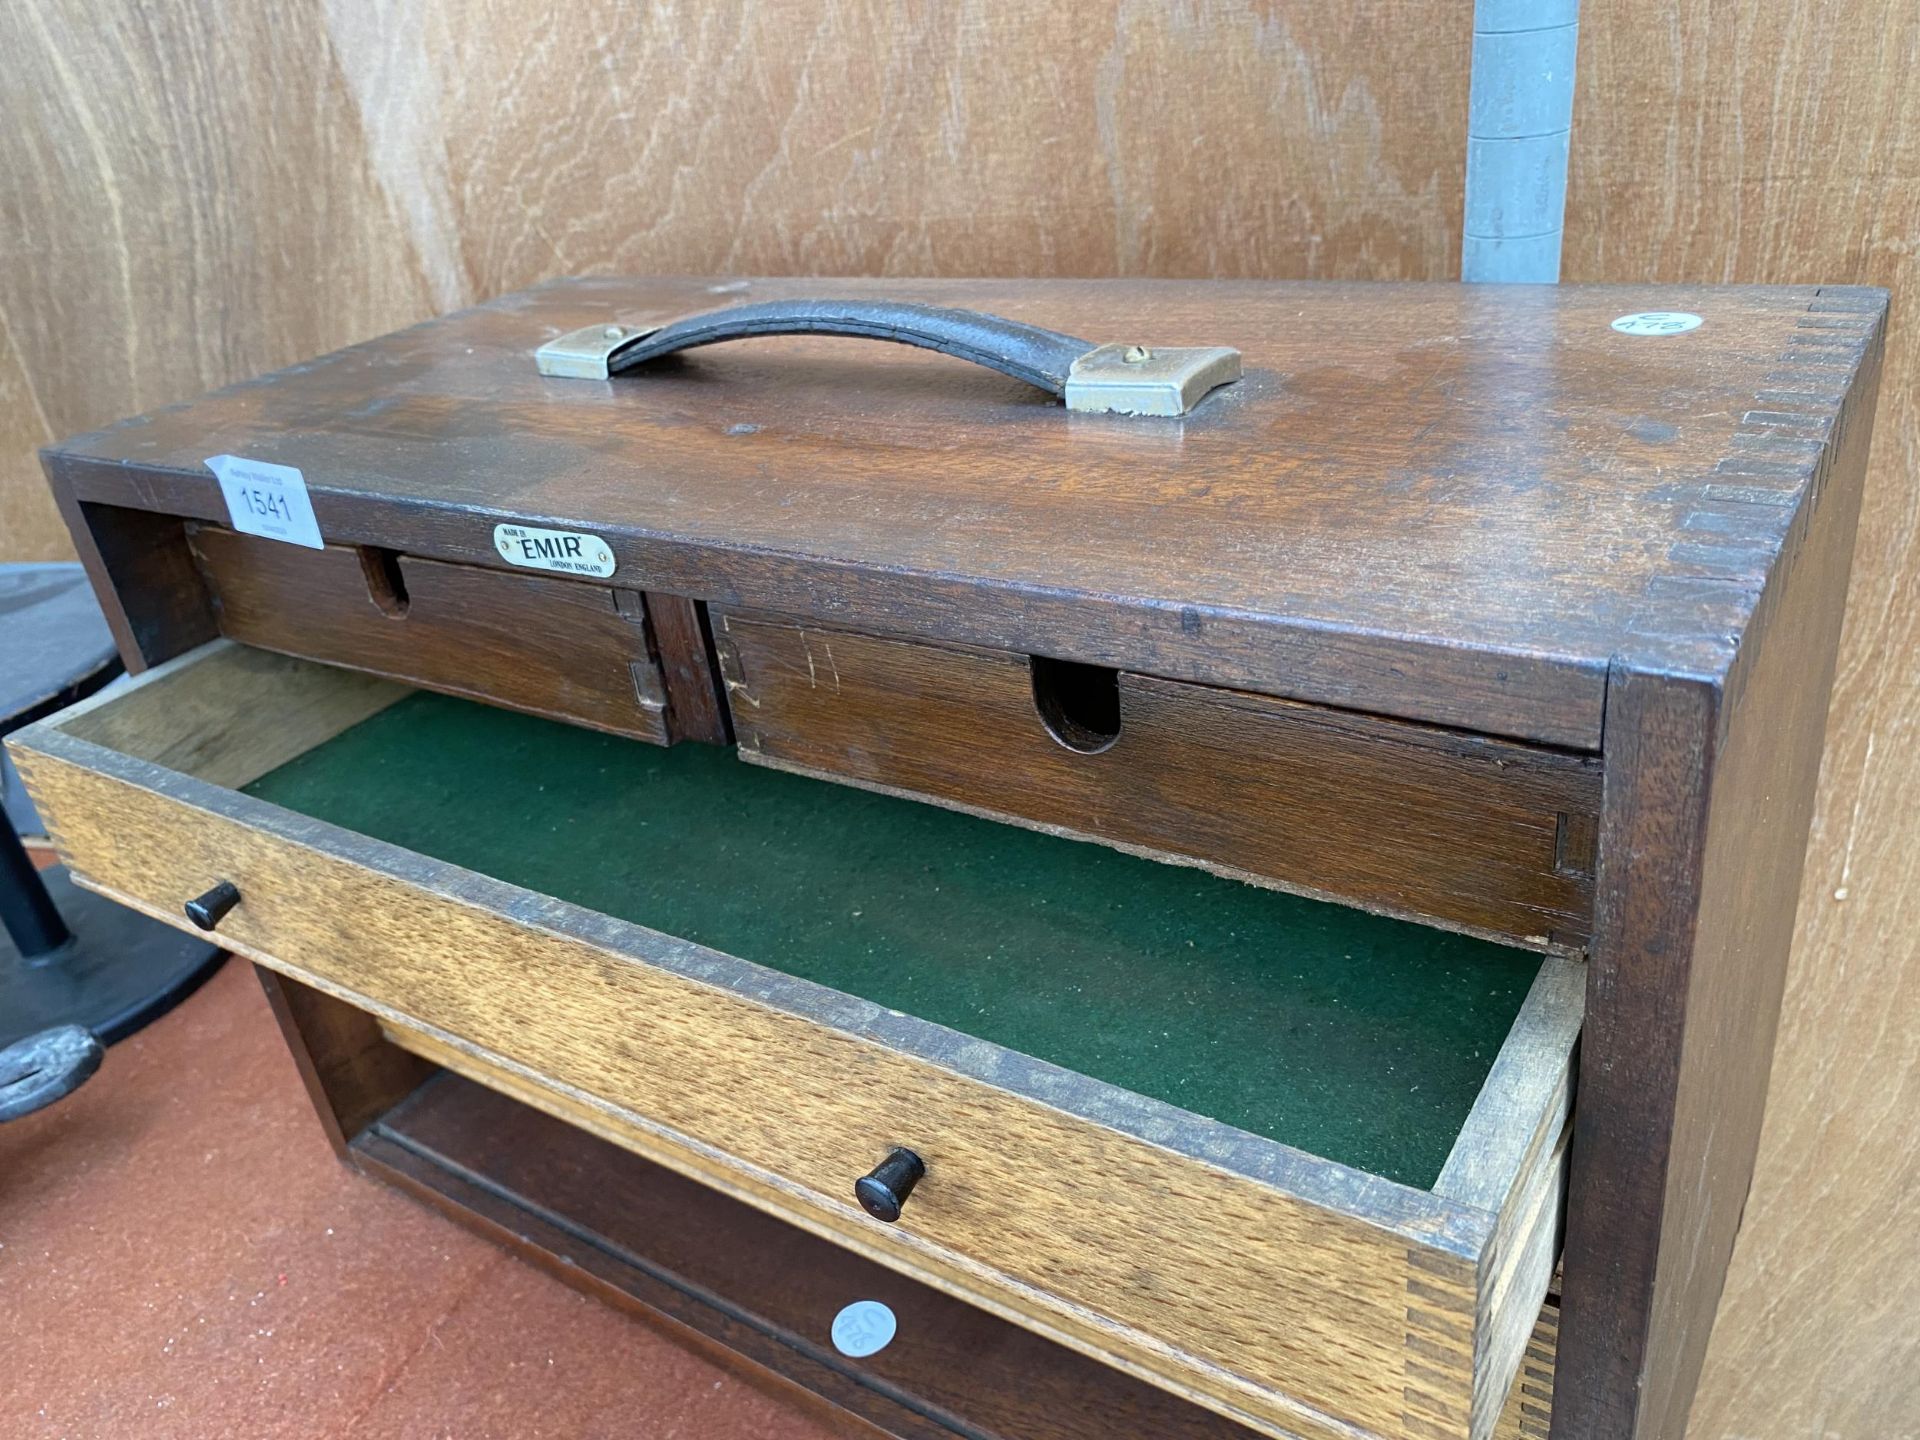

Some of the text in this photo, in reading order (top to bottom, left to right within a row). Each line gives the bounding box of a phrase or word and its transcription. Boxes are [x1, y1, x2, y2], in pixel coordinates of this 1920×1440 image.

[239, 487, 292, 522] 1541
[503, 528, 527, 538] MADE IN
[549, 559, 603, 573] LONDON ENGLAND
